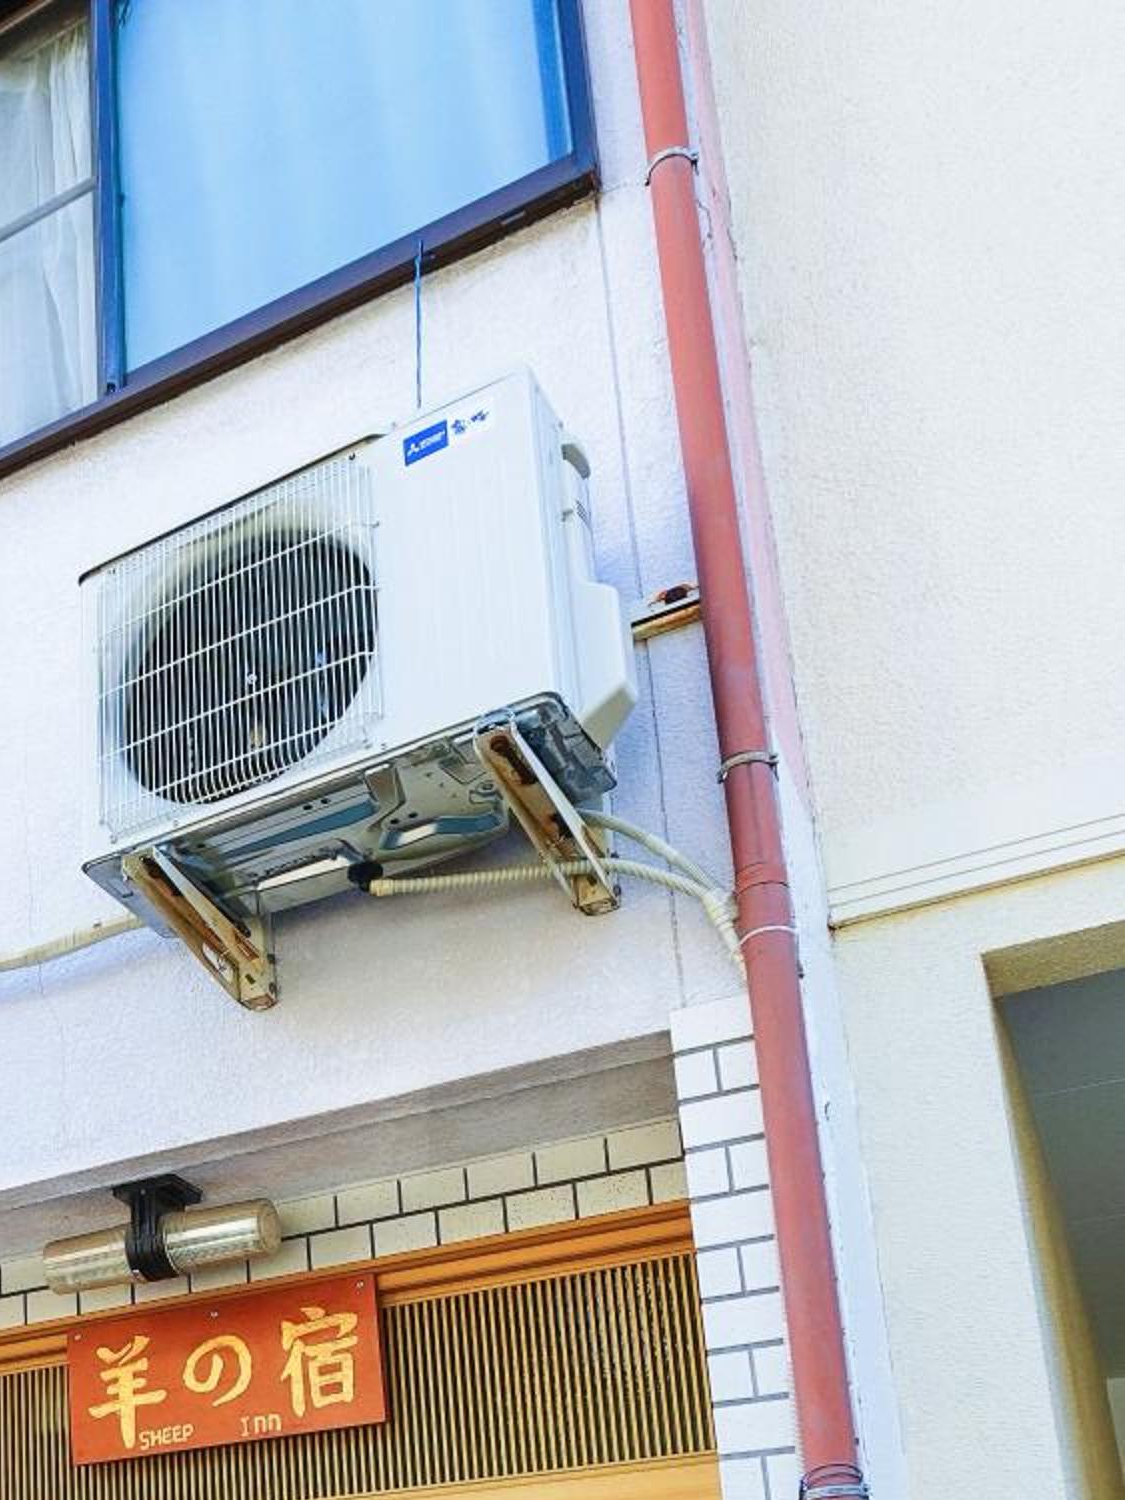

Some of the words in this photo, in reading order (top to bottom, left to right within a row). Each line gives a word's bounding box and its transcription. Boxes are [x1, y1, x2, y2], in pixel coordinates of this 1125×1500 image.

[88, 1307, 359, 1449] 羊の宿
[139, 1423, 194, 1451] SHEEP
[241, 1413, 282, 1438] Inn
